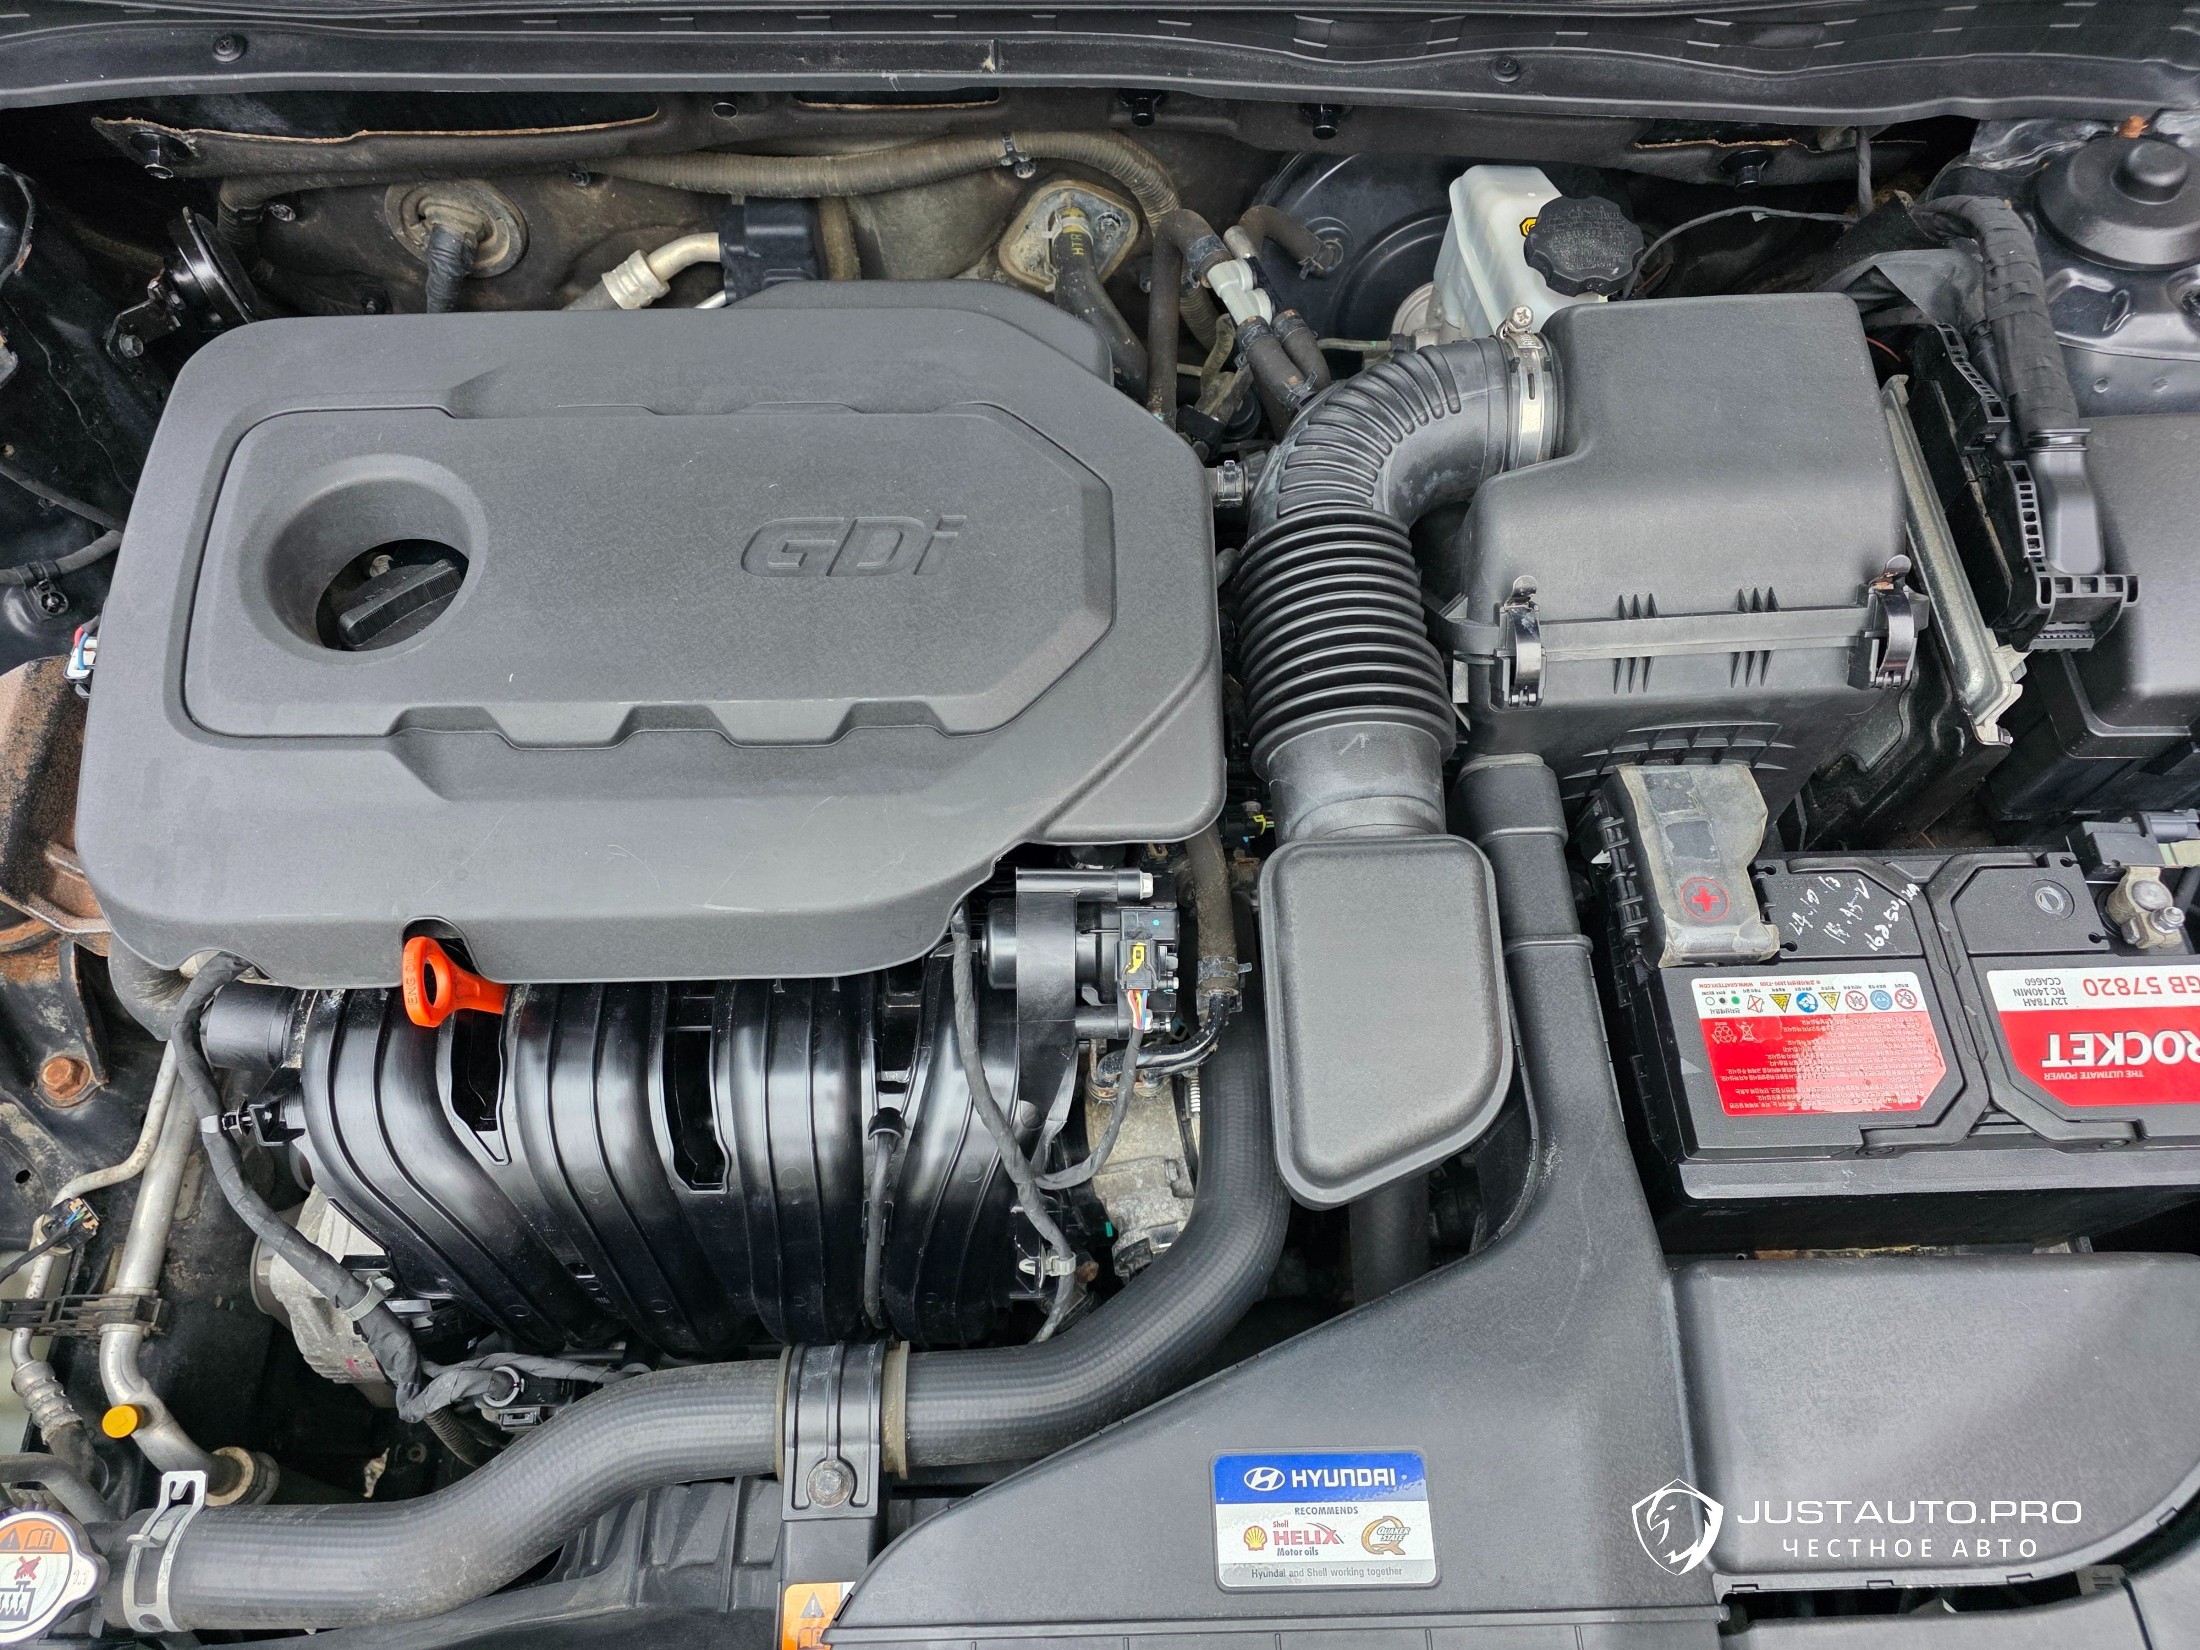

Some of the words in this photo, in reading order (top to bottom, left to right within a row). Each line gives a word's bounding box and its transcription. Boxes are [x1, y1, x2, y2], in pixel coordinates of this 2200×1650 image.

[1071, 233, 1085, 256] HTR
[740, 515, 967, 577] GDi
[405, 952, 416, 972] OIL
[2024, 977, 2061, 986] CCA660
[406, 977, 418, 1005] ENG
[2051, 987, 2065, 996] RC
[2083, 977, 2162, 997] 57820
[2044, 1072, 2078, 1081] POWER
[2080, 1071, 2123, 1080] ULTIMATE
[2126, 1070, 2144, 1078] THE
[1291, 1468, 1397, 1488] HYUNDAI
[1294, 1506, 1359, 1516] RECOMMENDS
[1272, 1520, 1289, 1528] Shell
[1377, 1526, 1410, 1536] QUAKER
[1273, 1529, 1340, 1546] HELIX
[1380, 1534, 1405, 1542] STATE
[1277, 1547, 1303, 1557] Motor
[1304, 1547, 1319, 1556] oils
[1251, 1569, 1286, 1579] Hyundai
[1288, 1569, 1304, 1577] and
[1307, 1568, 1328, 1577] Shell
[1331, 1568, 1364, 1578] working
[1366, 1567, 1402, 1578] together
